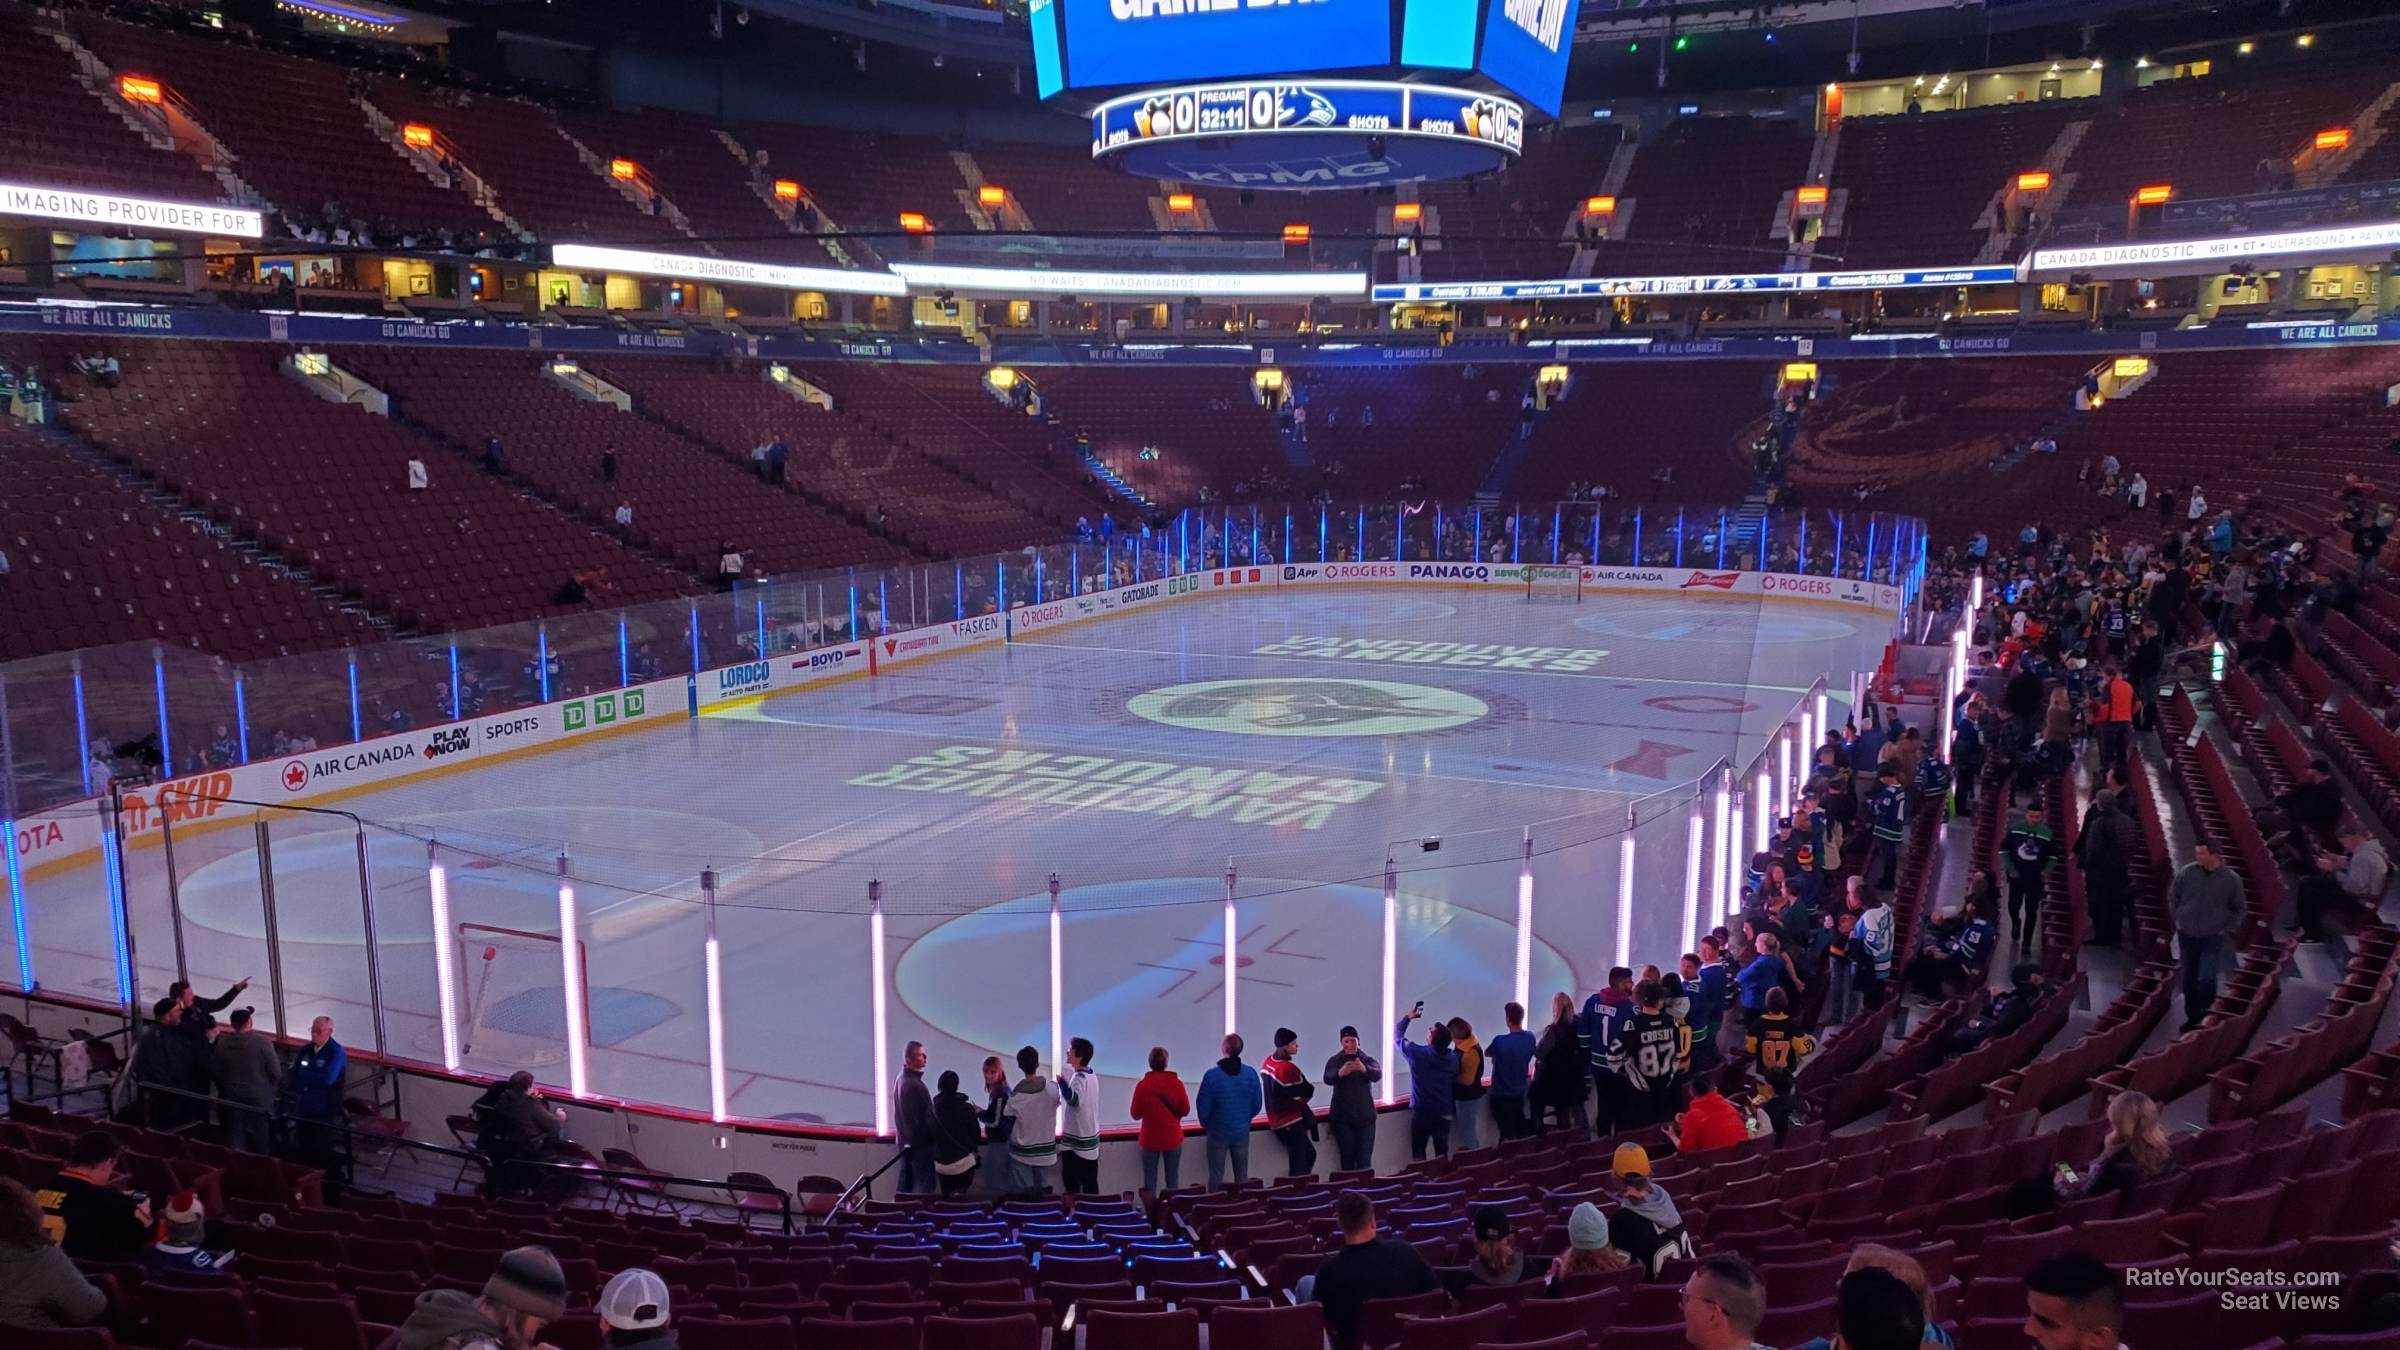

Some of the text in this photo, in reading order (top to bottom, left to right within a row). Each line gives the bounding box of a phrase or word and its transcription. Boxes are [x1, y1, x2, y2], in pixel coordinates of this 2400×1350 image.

[1201, 89, 1246, 103] PREGAME
[1176, 96, 1194, 130] 0
[1201, 107, 1244, 129] 32:11
[1252, 90, 1273, 126] 0
[1349, 114, 1389, 129] SHOTS
[1421, 119, 1454, 134] SHOTS
[1187, 161, 1390, 183] KPMG
[8, 191, 98, 216] IMAGING
[109, 201, 204, 227] PROVIDER
[213, 213, 245, 230] FOR
[2040, 252, 2097, 266] CANADA
[2103, 244, 2196, 262] DIAGNOSTIC
[2210, 243, 2229, 254] MRI
[2243, 241, 2256, 251] CT
[2269, 234, 2346, 249] ULTRASOUND
[698, 261, 755, 279] DIAGNOSTIC
[65, 309, 89, 325] ARE
[93, 311, 114, 327] ALL
[117, 313, 172, 329] CANUCKS
[382, 323, 451, 339] GO CANUCKS GO
[2281, 324, 2378, 339] WE ARE ALL CANUCKS
[1341, 565, 1396, 578] ROGERS
[1410, 565, 1489, 582] PANAGO
[1597, 571, 1663, 582] AIR CANADA
[1122, 584, 1159, 604] GATORADE
[1779, 577, 1832, 594] ROGERS
[1031, 605, 1064, 624] ROGERS
[959, 616, 998, 637] FASKEN
[811, 650, 843, 667] BOYD
[720, 661, 769, 689] LORDCO
[433, 726, 470, 744] PLAY
[485, 717, 539, 740] SPORTS
[431, 737, 471, 757] NOW
[313, 743, 415, 779] AIR CANADA
[152, 771, 233, 828] SKIP
[1602, 1016, 1609, 1047] 1
[1640, 1028, 1674, 1044] CROSBY
[1639, 1041, 1675, 1077] 87
